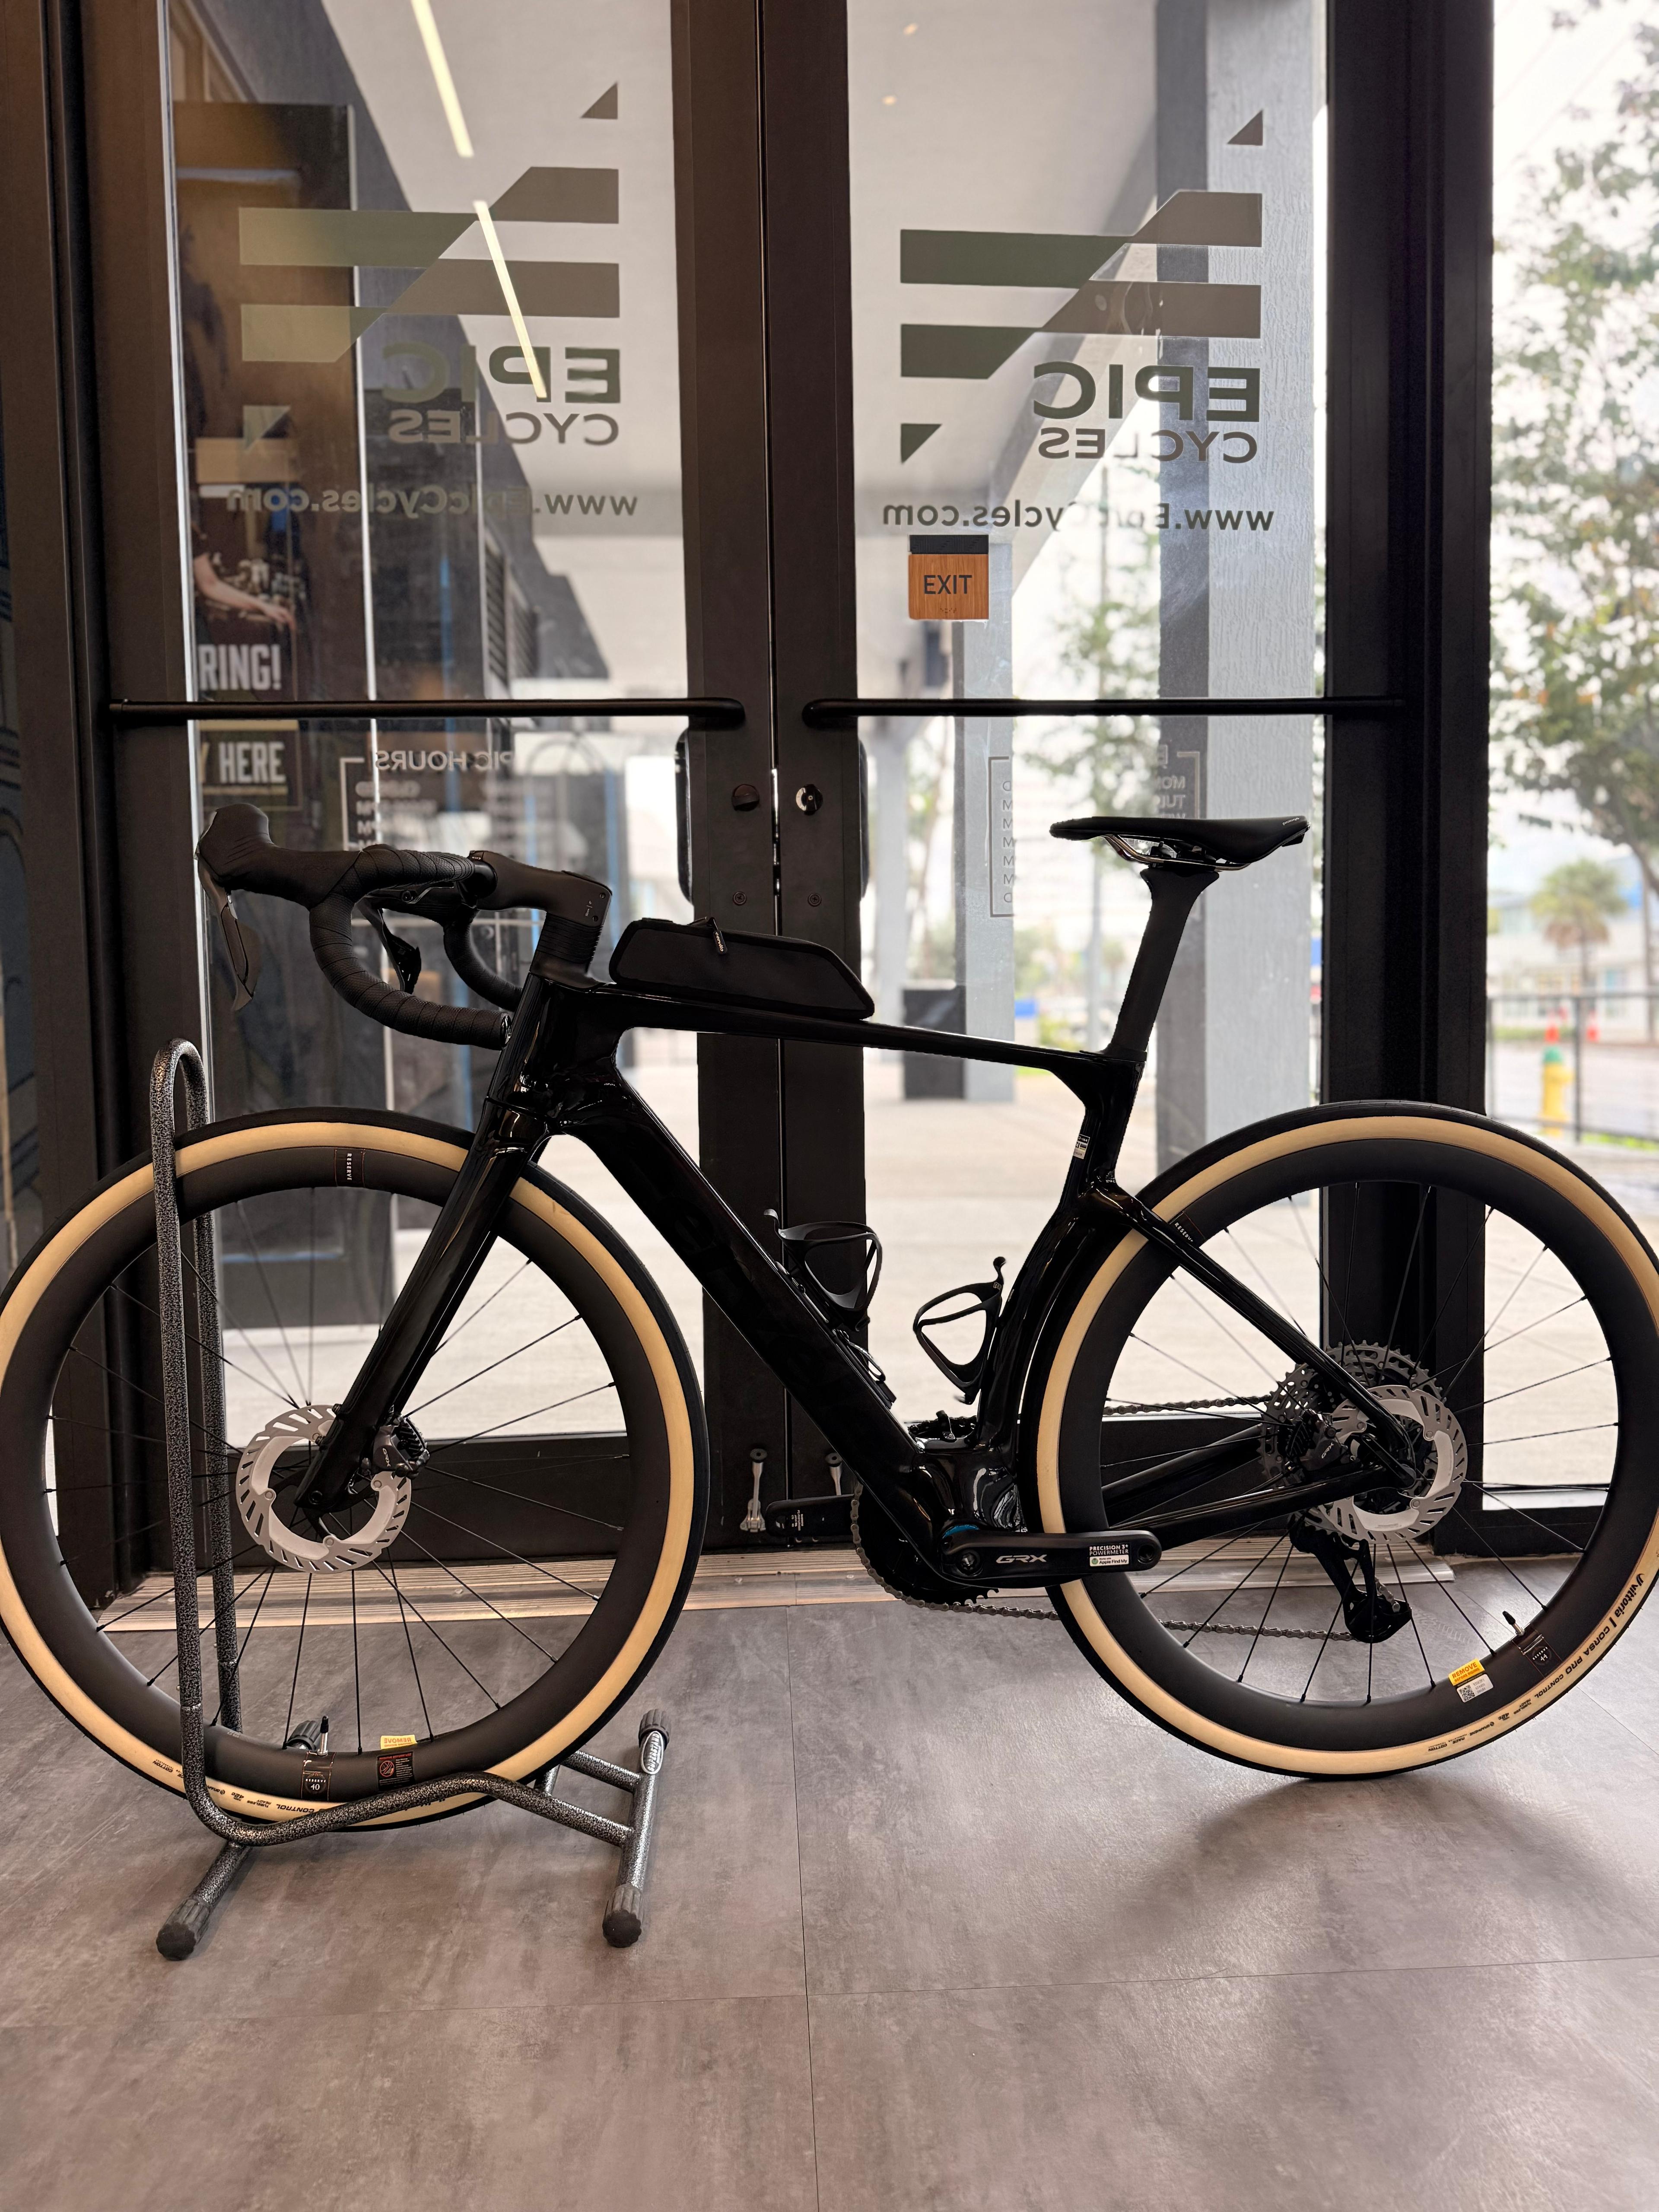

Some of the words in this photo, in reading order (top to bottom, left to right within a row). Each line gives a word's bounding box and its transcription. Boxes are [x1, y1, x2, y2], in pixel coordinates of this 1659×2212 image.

[924, 575, 972, 595] EXIT
[218, 741, 286, 783] HERE
[996, 1554, 1047, 1564] GRX
[1583, 1626, 1610, 1656] CORSA
[1452, 1662, 1478, 1679] REMOVE
[1566, 1656, 1583, 1674] PRO
[1534, 1674, 1564, 1698] CONTROL
[276, 1804, 315, 1813] CONTROL
